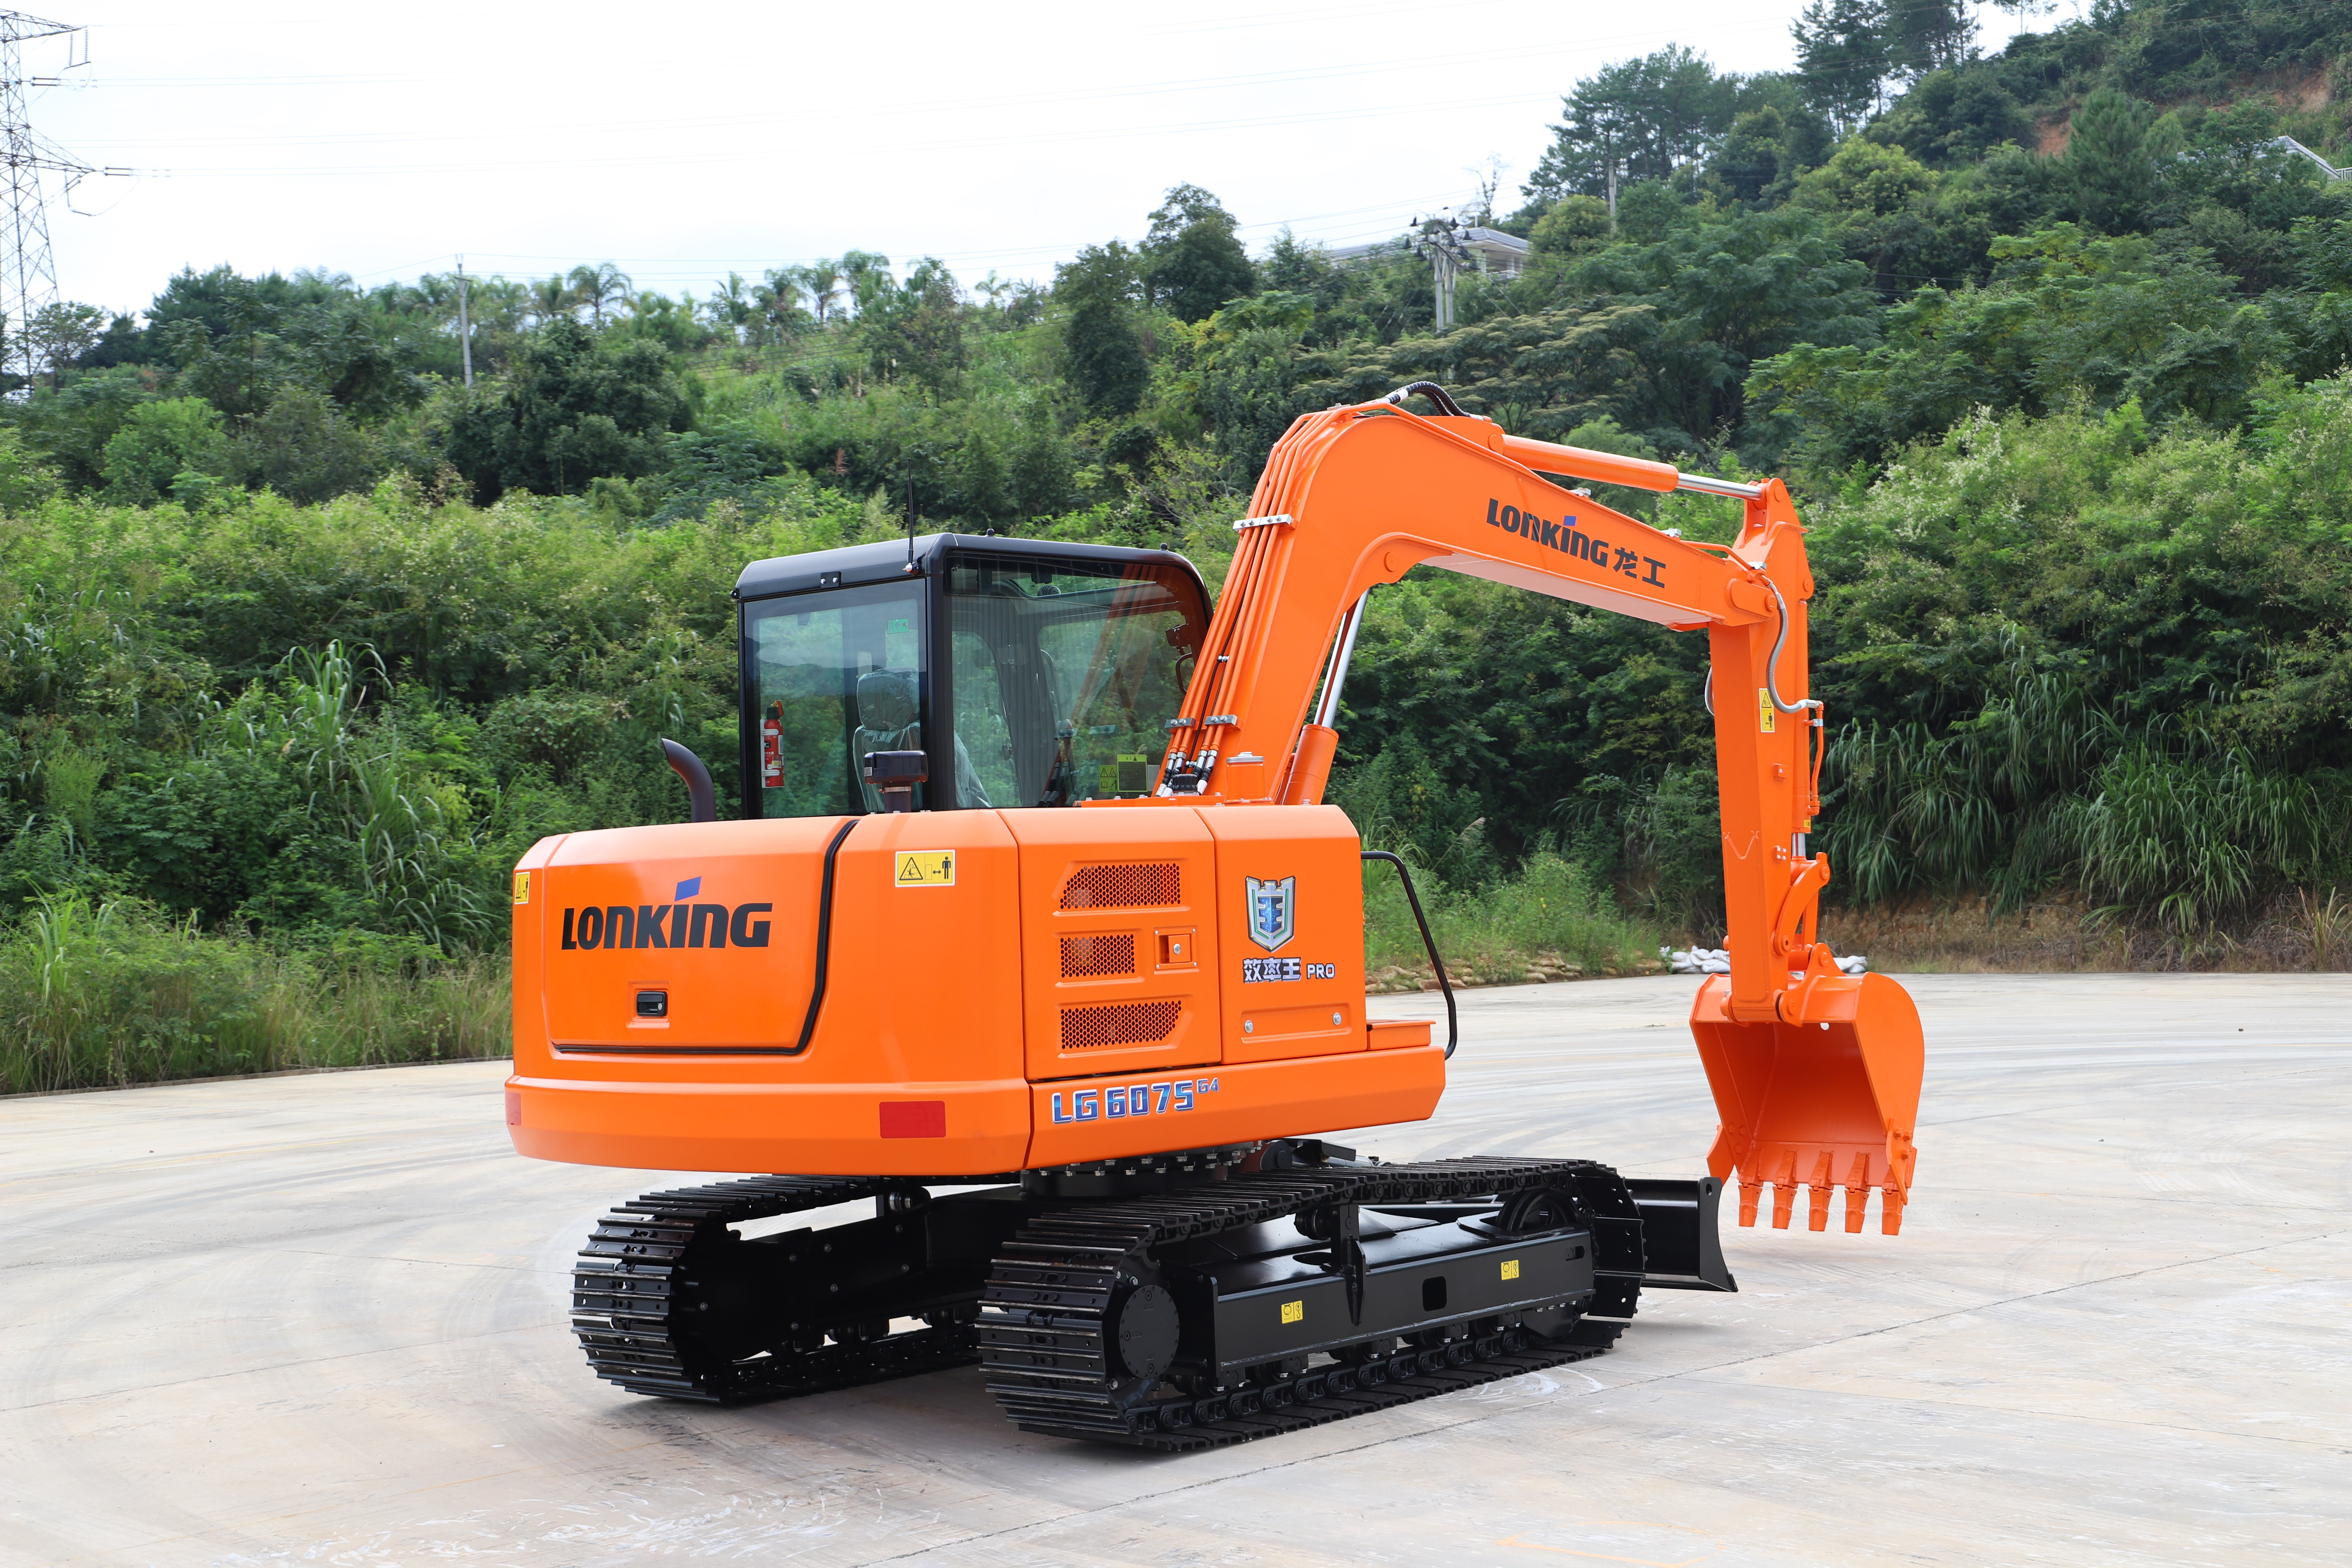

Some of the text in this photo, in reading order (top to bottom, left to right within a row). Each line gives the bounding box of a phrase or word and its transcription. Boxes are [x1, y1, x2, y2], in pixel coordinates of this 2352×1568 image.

[1487, 498, 1666, 588] LONKING 龙工
[561, 876, 773, 950] LONKING
[1243, 957, 1335, 983] 效率王 PRO
[1197, 1077, 1219, 1093] G4
